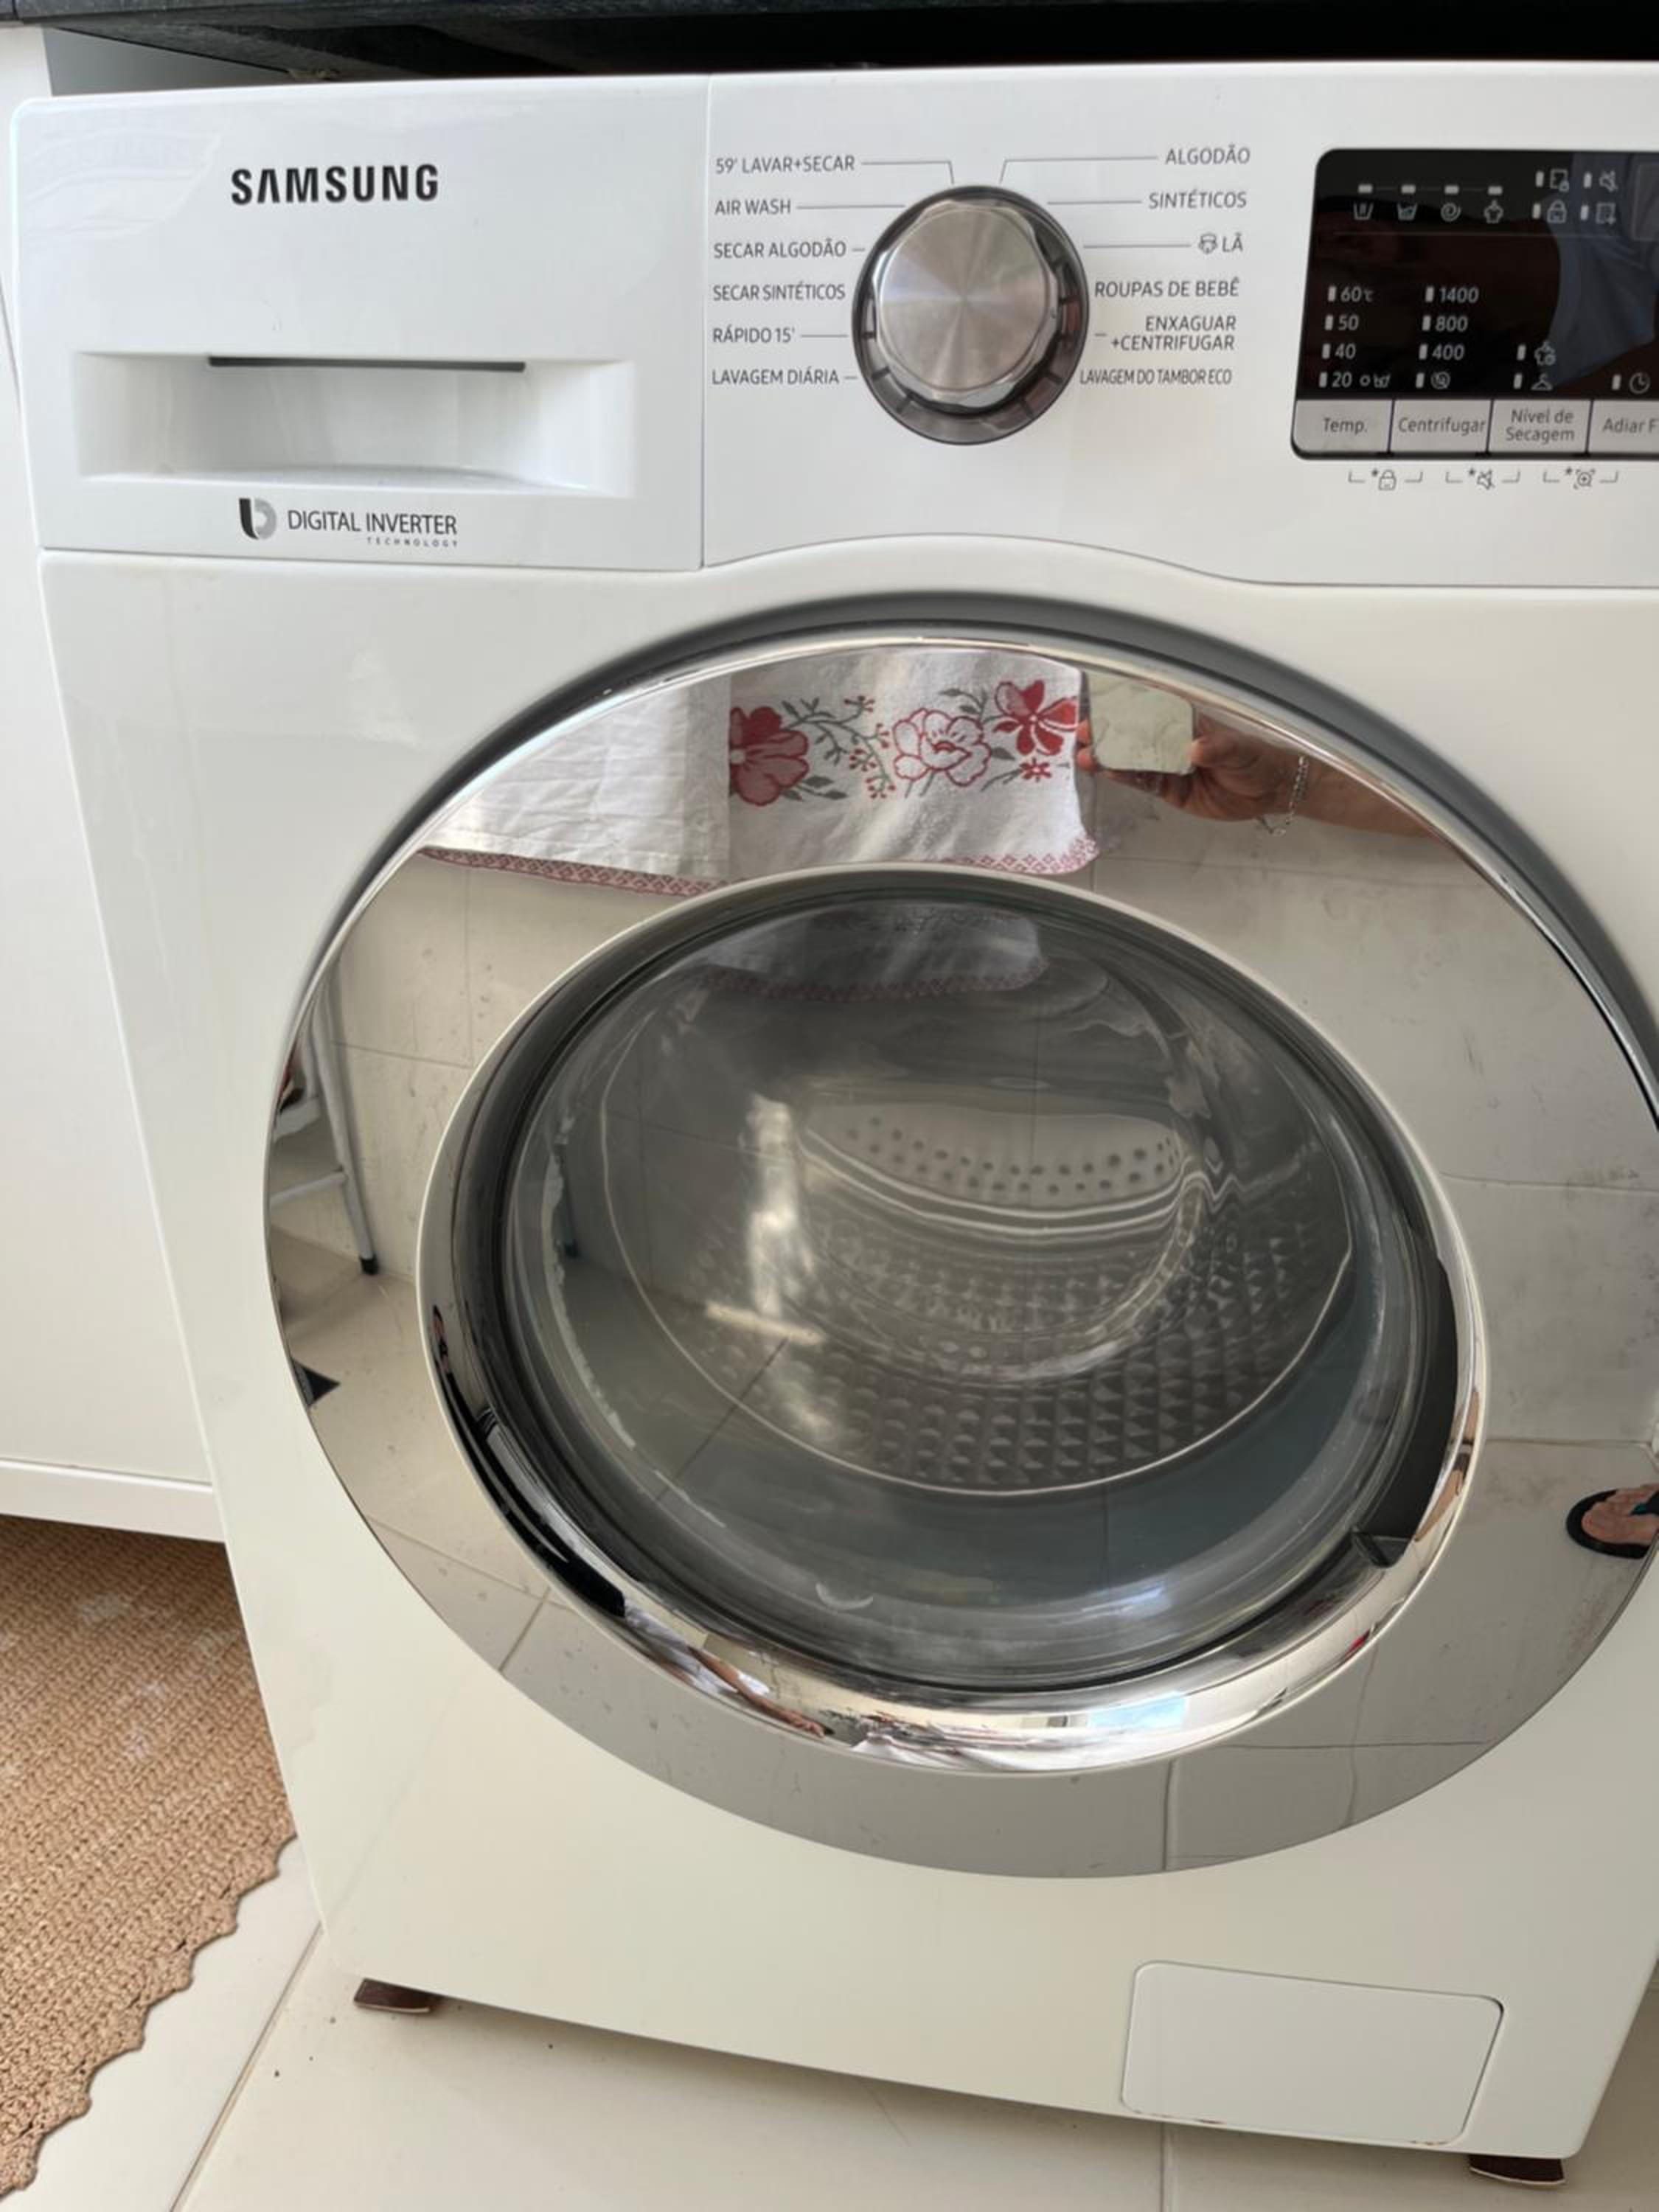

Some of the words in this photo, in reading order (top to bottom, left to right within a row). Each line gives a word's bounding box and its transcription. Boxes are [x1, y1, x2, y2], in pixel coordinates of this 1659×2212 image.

[1165, 144, 1251, 164] ALGODÃO
[742, 155, 855, 174] LAVAR+SECAR
[231, 163, 439, 206] SAMSUNG
[714, 200, 741, 215] AIR
[745, 198, 791, 215] WASH
[1149, 189, 1247, 209] SINTÉTICOS
[714, 241, 765, 259] SECAR
[768, 237, 846, 258] ALGODÃO
[1222, 232, 1243, 253] LÃ
[713, 284, 760, 301] SECAR
[762, 280, 846, 300] SINTÉTICOS
[1094, 279, 1164, 298] ROUPAS
[1167, 279, 1190, 298] DE
[1195, 275, 1239, 297] BEBÊ
[1439, 287, 1479, 303] 1400
[1145, 315, 1237, 332] ENXAGUAR
[1338, 315, 1360, 331] 50
[1435, 316, 1468, 332] 800
[712, 324, 772, 344] RÁPIDO
[1110, 334, 1235, 352] +CENTRIFUGAR
[1335, 343, 1357, 360] 40
[1431, 344, 1465, 361] 400
[712, 369, 784, 386] LAVAGEM
[787, 366, 840, 385] DIÁRIA
[1079, 369, 1135, 386] LAVAGEM
[1136, 369, 1155, 385] DO
[1157, 369, 1206, 385] TAMBOR
[1208, 369, 1233, 385] ECO
[1332, 371, 1353, 388] 20
[1554, 410, 1574, 424] de
[1602, 418, 1645, 434] Adiar
[1324, 418, 1368, 435] Temp.
[1398, 417, 1486, 437] Centrifugar
[1506, 427, 1575, 445] Secagem
[287, 510, 362, 532] DIGITAL
[366, 513, 458, 535] INVERTER
[366, 536, 459, 548] TECHNOLOGY
